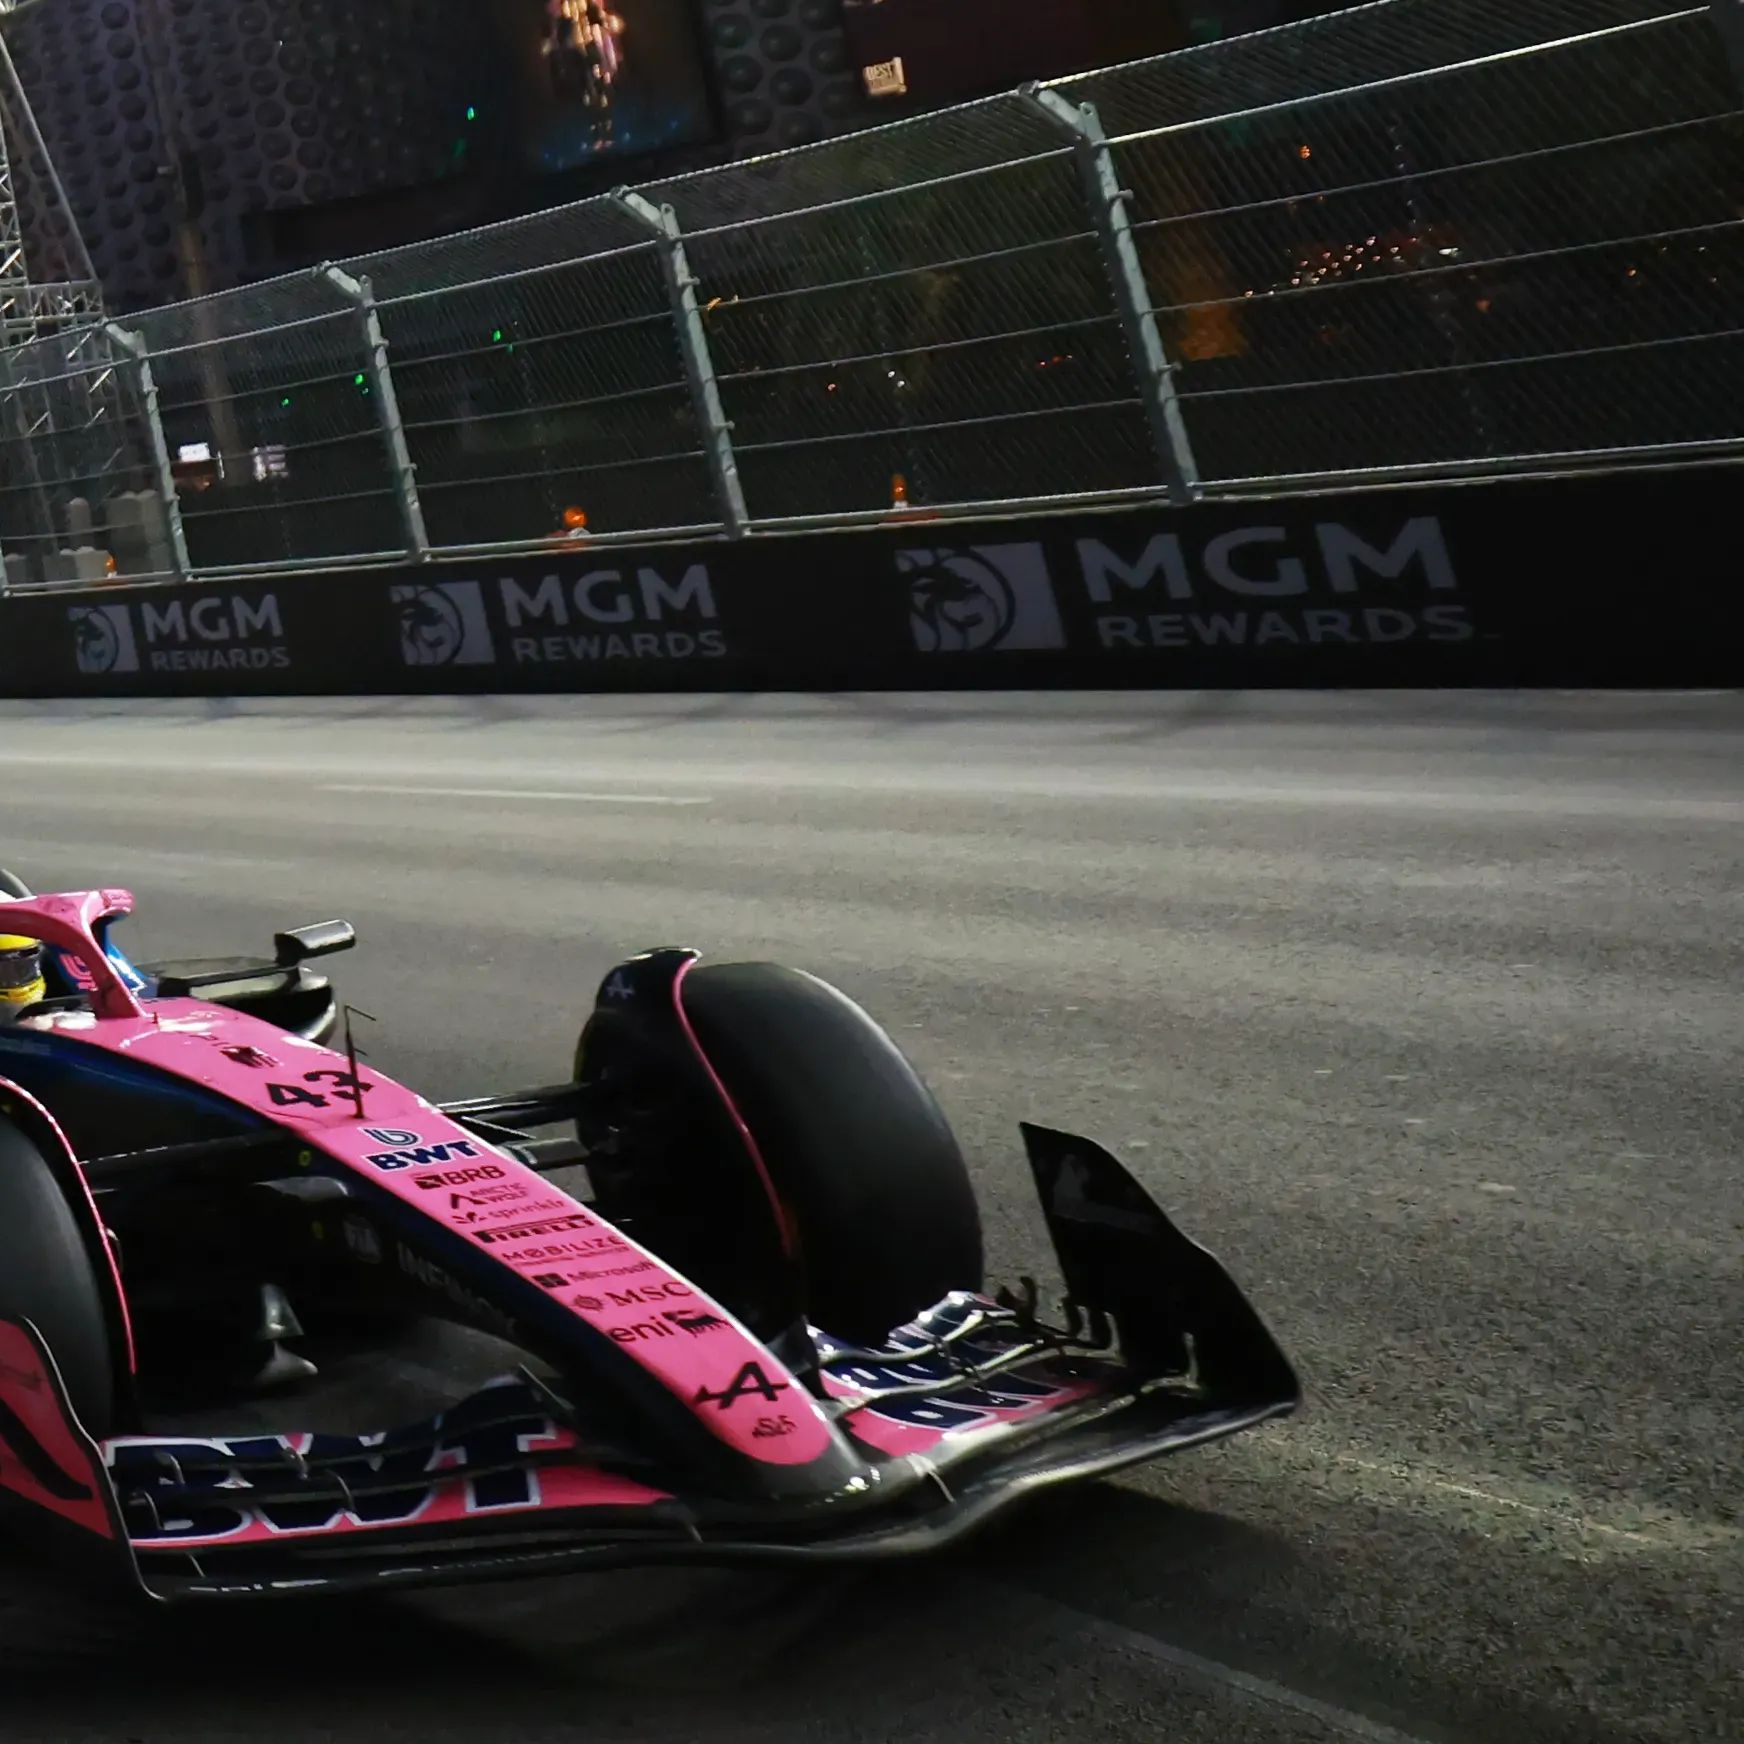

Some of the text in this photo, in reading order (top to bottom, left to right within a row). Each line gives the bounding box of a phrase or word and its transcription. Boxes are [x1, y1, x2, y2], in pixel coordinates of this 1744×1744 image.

[1075, 515, 1459, 603] MGM
[497, 562, 718, 630] MGM
[140, 593, 284, 644] MGM
[1095, 603, 1475, 648] REWARDS
[150, 645, 292, 673] REWARDS
[512, 629, 727, 662] REWARDS
[266, 1070, 375, 1108] 43
[362, 1139, 483, 1171] BWT
[443, 1165, 506, 1186] BRB
[472, 1214, 595, 1243] PIRELLI
[567, 1259, 660, 1283] Microsoft
[605, 1280, 694, 1307] MSC
[608, 1316, 675, 1343] eni
